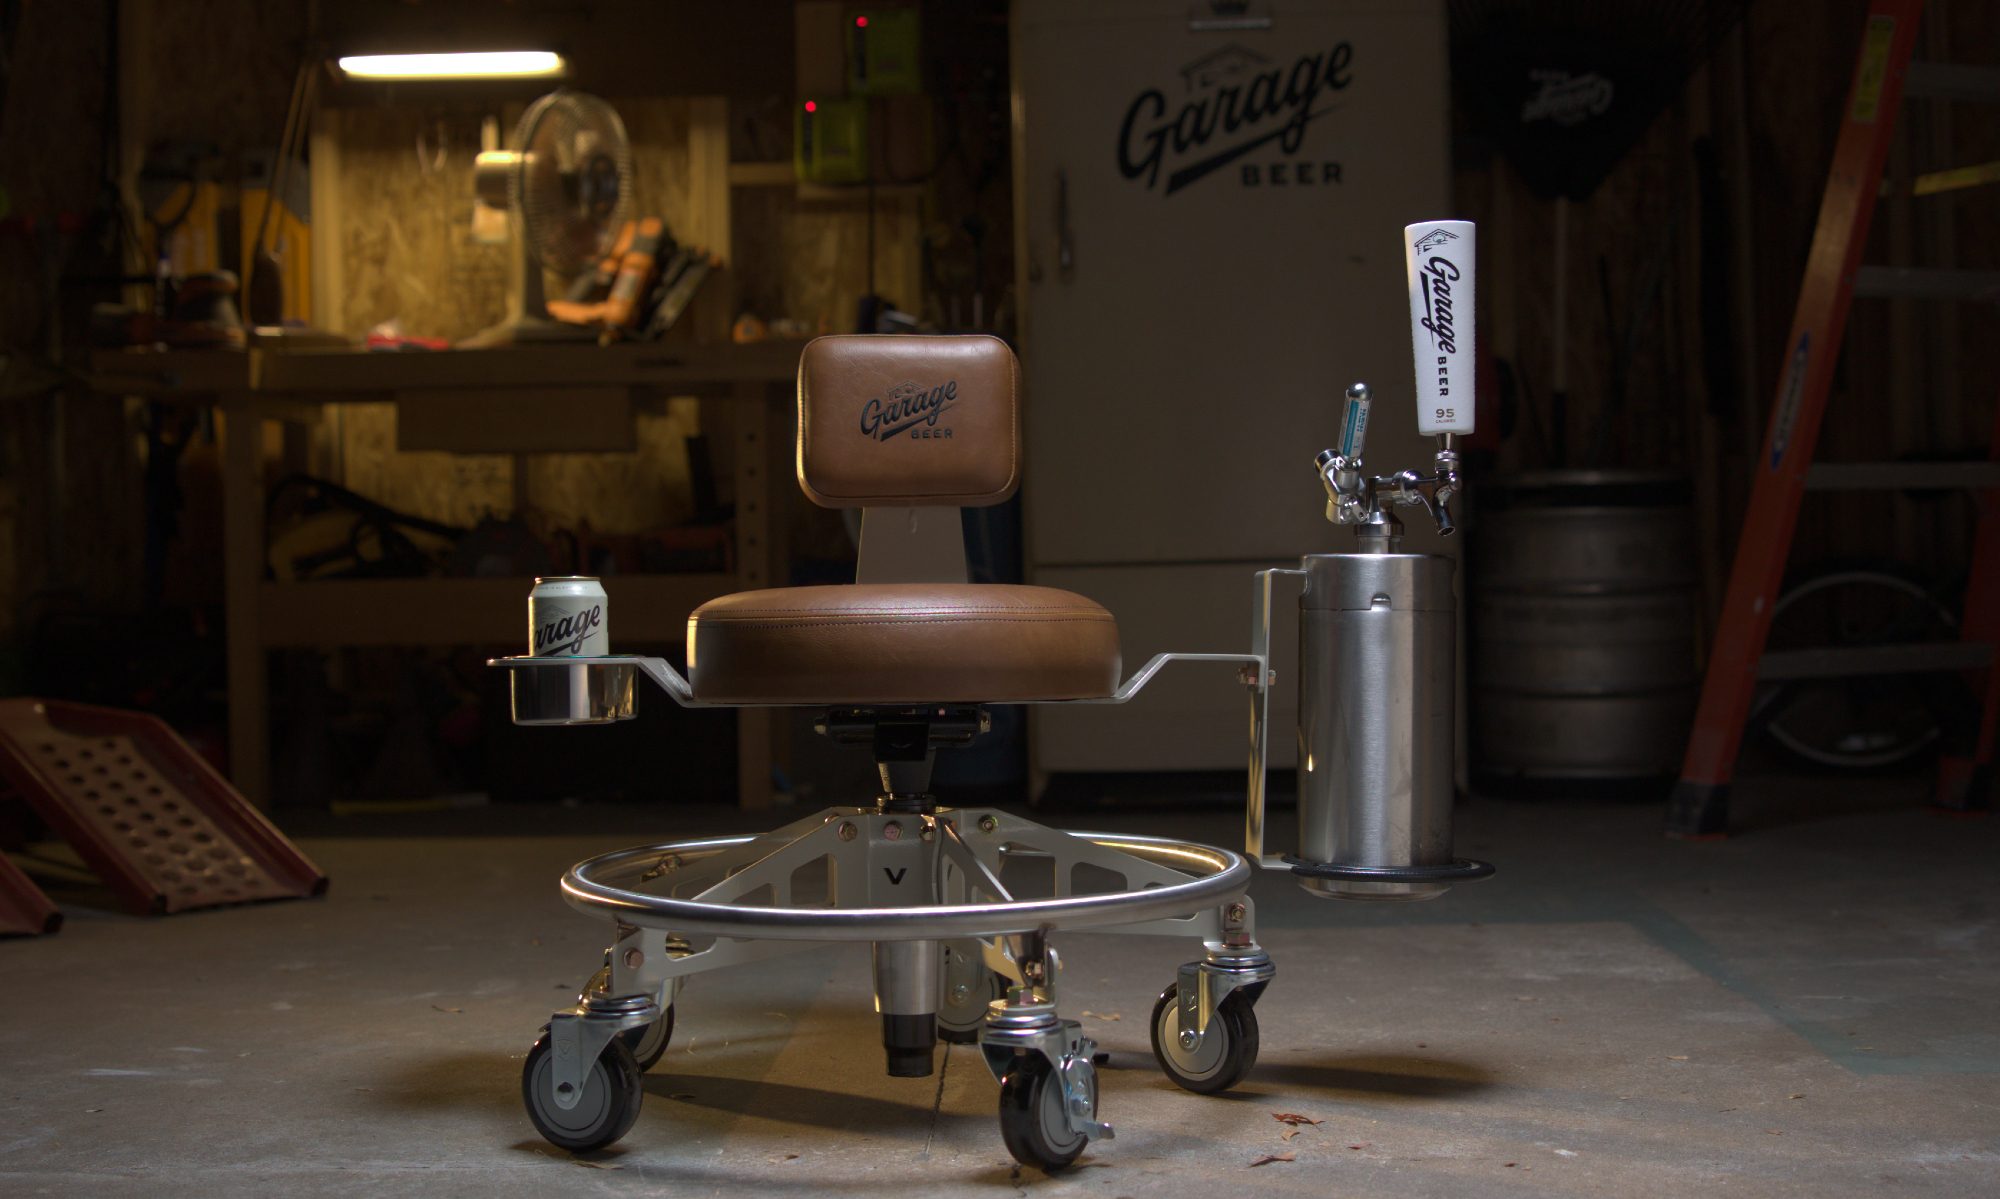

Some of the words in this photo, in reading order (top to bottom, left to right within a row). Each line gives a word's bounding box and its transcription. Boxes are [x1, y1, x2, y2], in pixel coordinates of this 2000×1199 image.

[1118, 41, 1353, 192] Garage
[1242, 162, 1344, 187] BEER
[1420, 256, 1461, 355] Garage
[1437, 356, 1450, 396] BEER
[861, 380, 958, 440] Garage
[1435, 408, 1455, 419] 95
[911, 429, 953, 440] BEER
[534, 604, 601, 655] arage
